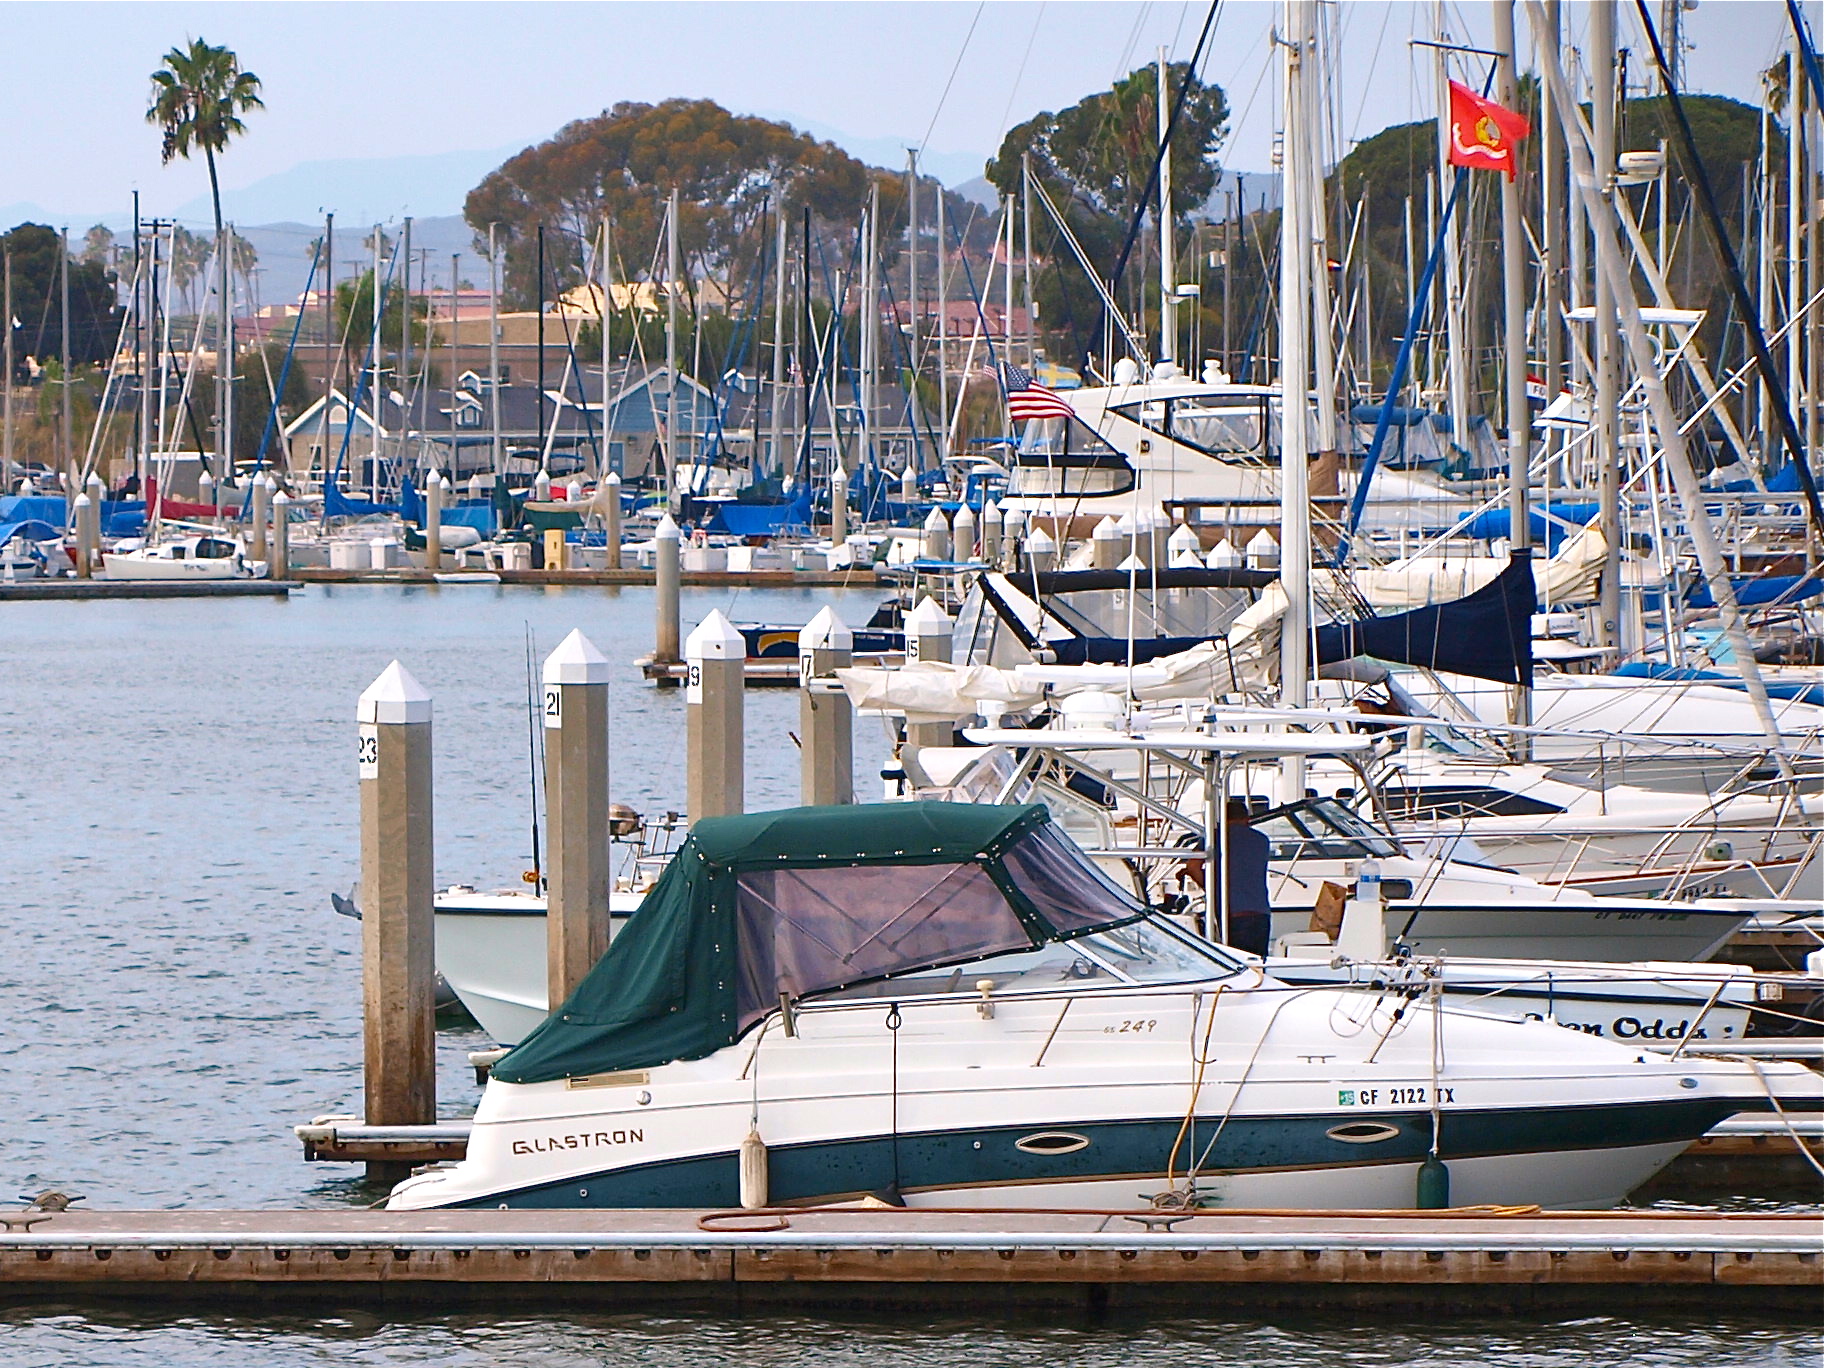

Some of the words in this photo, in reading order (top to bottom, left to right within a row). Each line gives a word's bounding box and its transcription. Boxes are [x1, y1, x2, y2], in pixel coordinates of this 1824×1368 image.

[907, 640, 918, 657] 15
[802, 655, 812, 677] 17
[546, 692, 560, 716] 21
[1119, 1019, 1158, 1033] 249
[1613, 1017, 1707, 1039] Odds
[1360, 1090, 1378, 1105] CF
[1390, 1088, 1426, 1105] 2122
[1435, 1088, 1456, 1103] TX
[512, 1129, 644, 1155] GLASTRON
